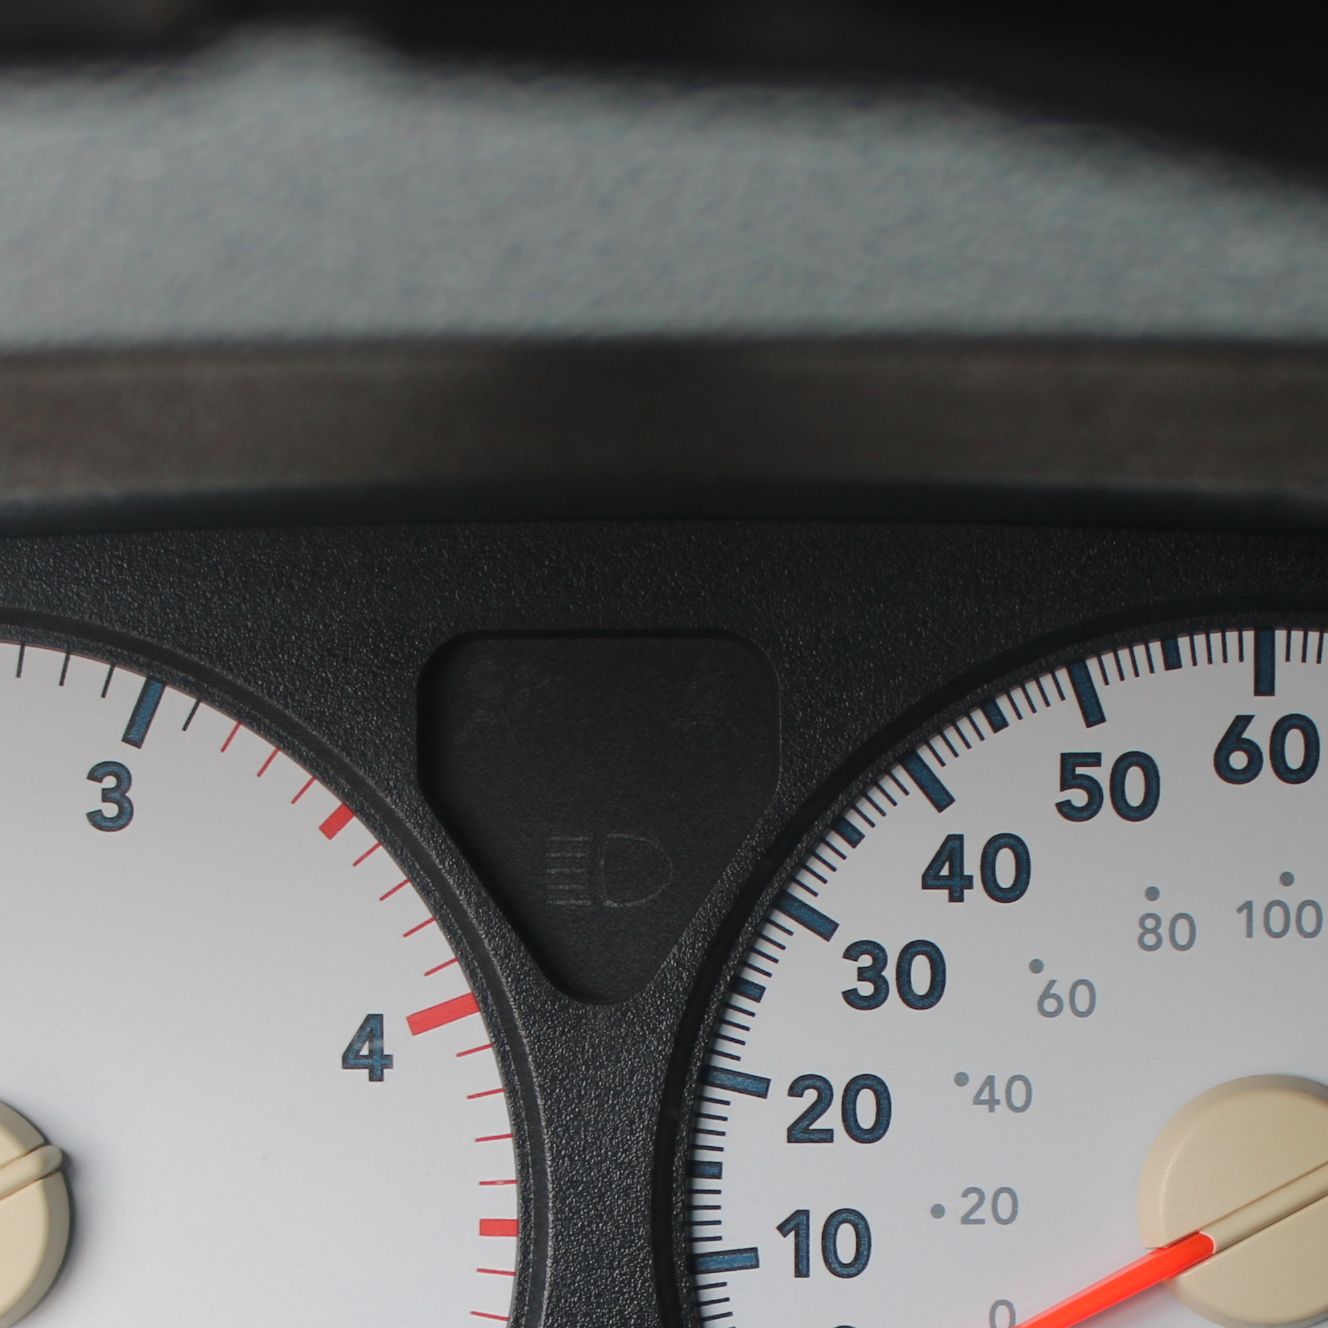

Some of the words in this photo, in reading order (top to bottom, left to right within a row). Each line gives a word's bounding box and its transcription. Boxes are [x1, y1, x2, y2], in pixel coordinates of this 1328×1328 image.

[1213, 713, 1321, 785] 60
[85, 760, 135, 832] 3
[1055, 751, 1161, 823] 50
[921, 833, 1032, 904] 40
[1137, 912, 1197, 952] 80
[1235, 899, 1325, 940] 100
[840, 939, 947, 1011] 30
[1036, 979, 1097, 1018] 60
[341, 1013, 394, 1082] 4
[786, 1073, 892, 1144] 20
[972, 1074, 1034, 1114] 40
[959, 1186, 1020, 1226] 20
[776, 1207, 873, 1279] 10
